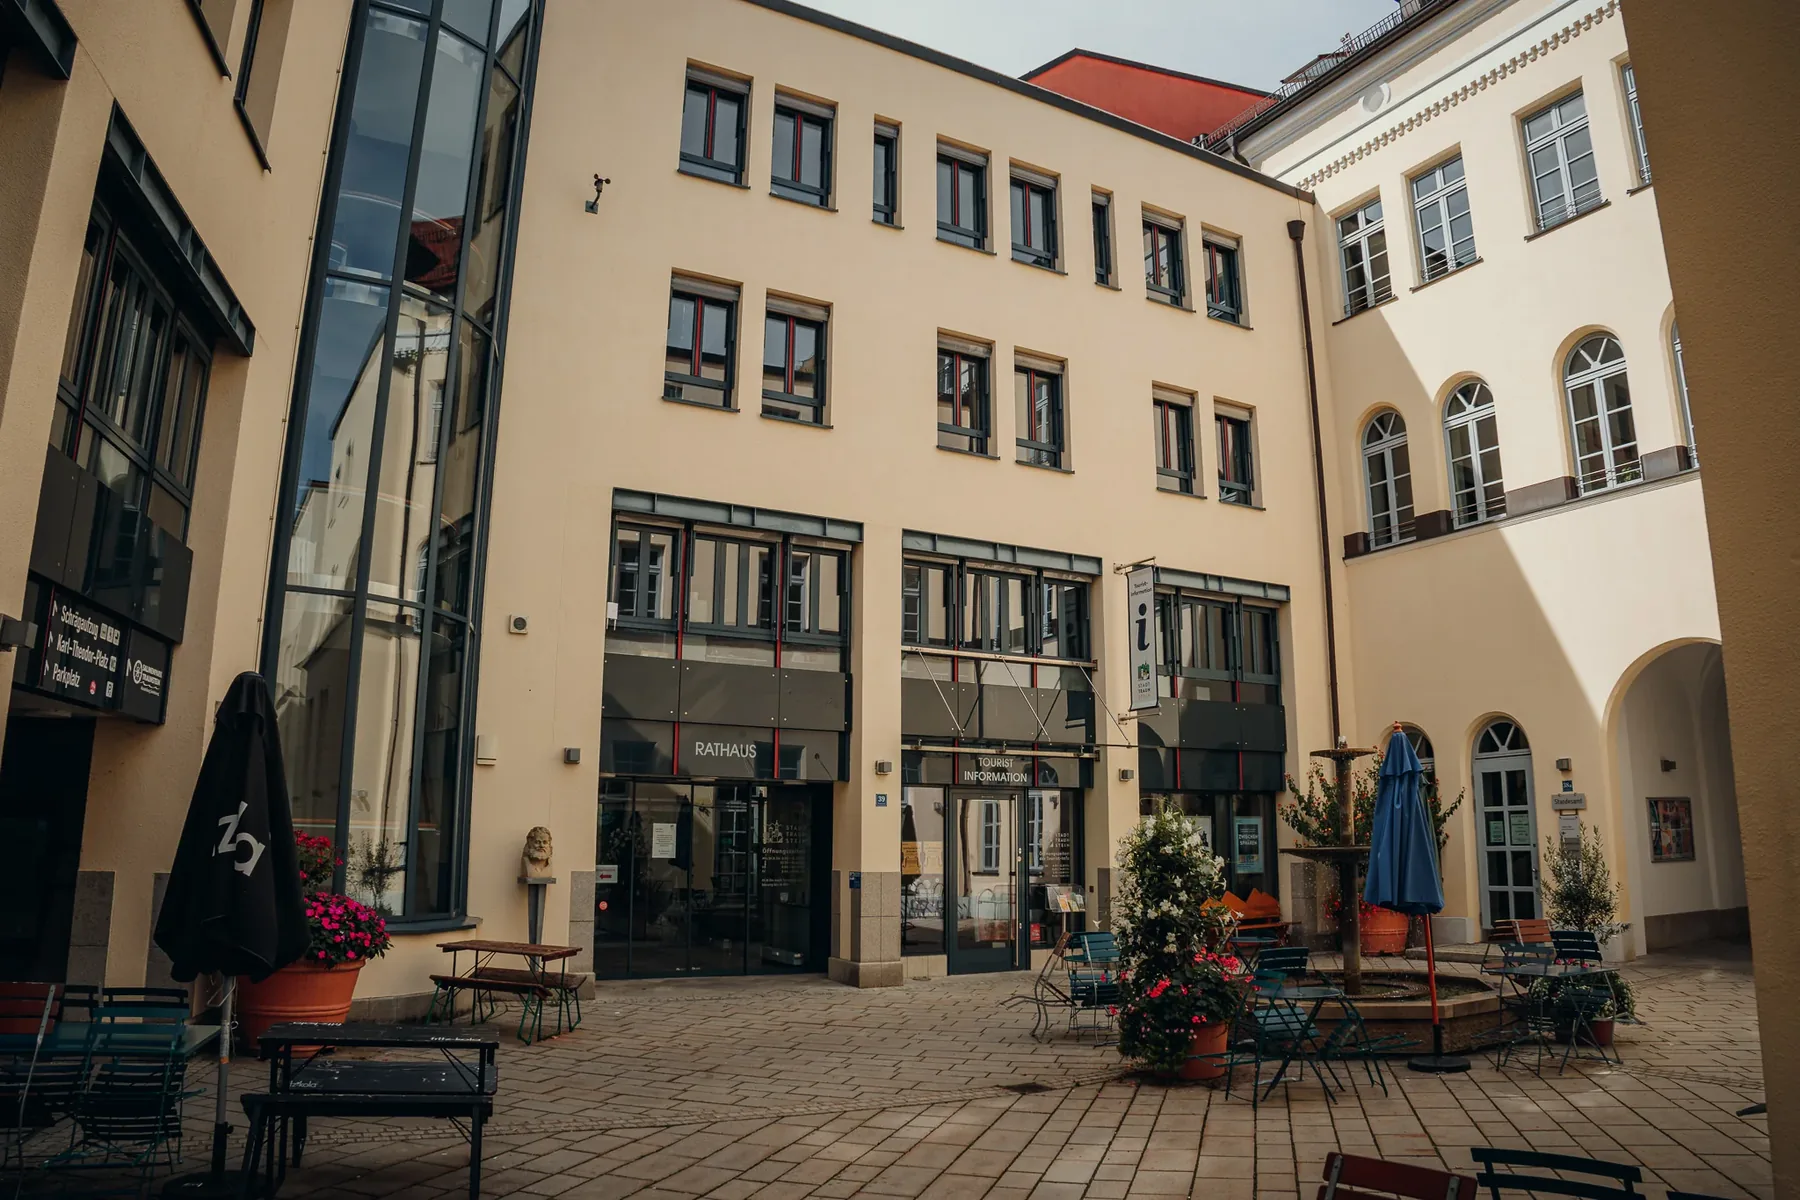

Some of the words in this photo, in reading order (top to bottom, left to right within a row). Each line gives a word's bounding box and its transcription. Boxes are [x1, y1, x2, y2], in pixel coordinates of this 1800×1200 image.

[60, 605, 99, 640] Schrägaufzug
[56, 634, 109, 669] Karl-Theodor-Platz
[53, 664, 81, 688] Parkplatz
[695, 742, 757, 758] RATHAUS
[978, 757, 1014, 768] TOURIST
[964, 770, 1028, 783] INFORMATION
[878, 795, 886, 803] 39
